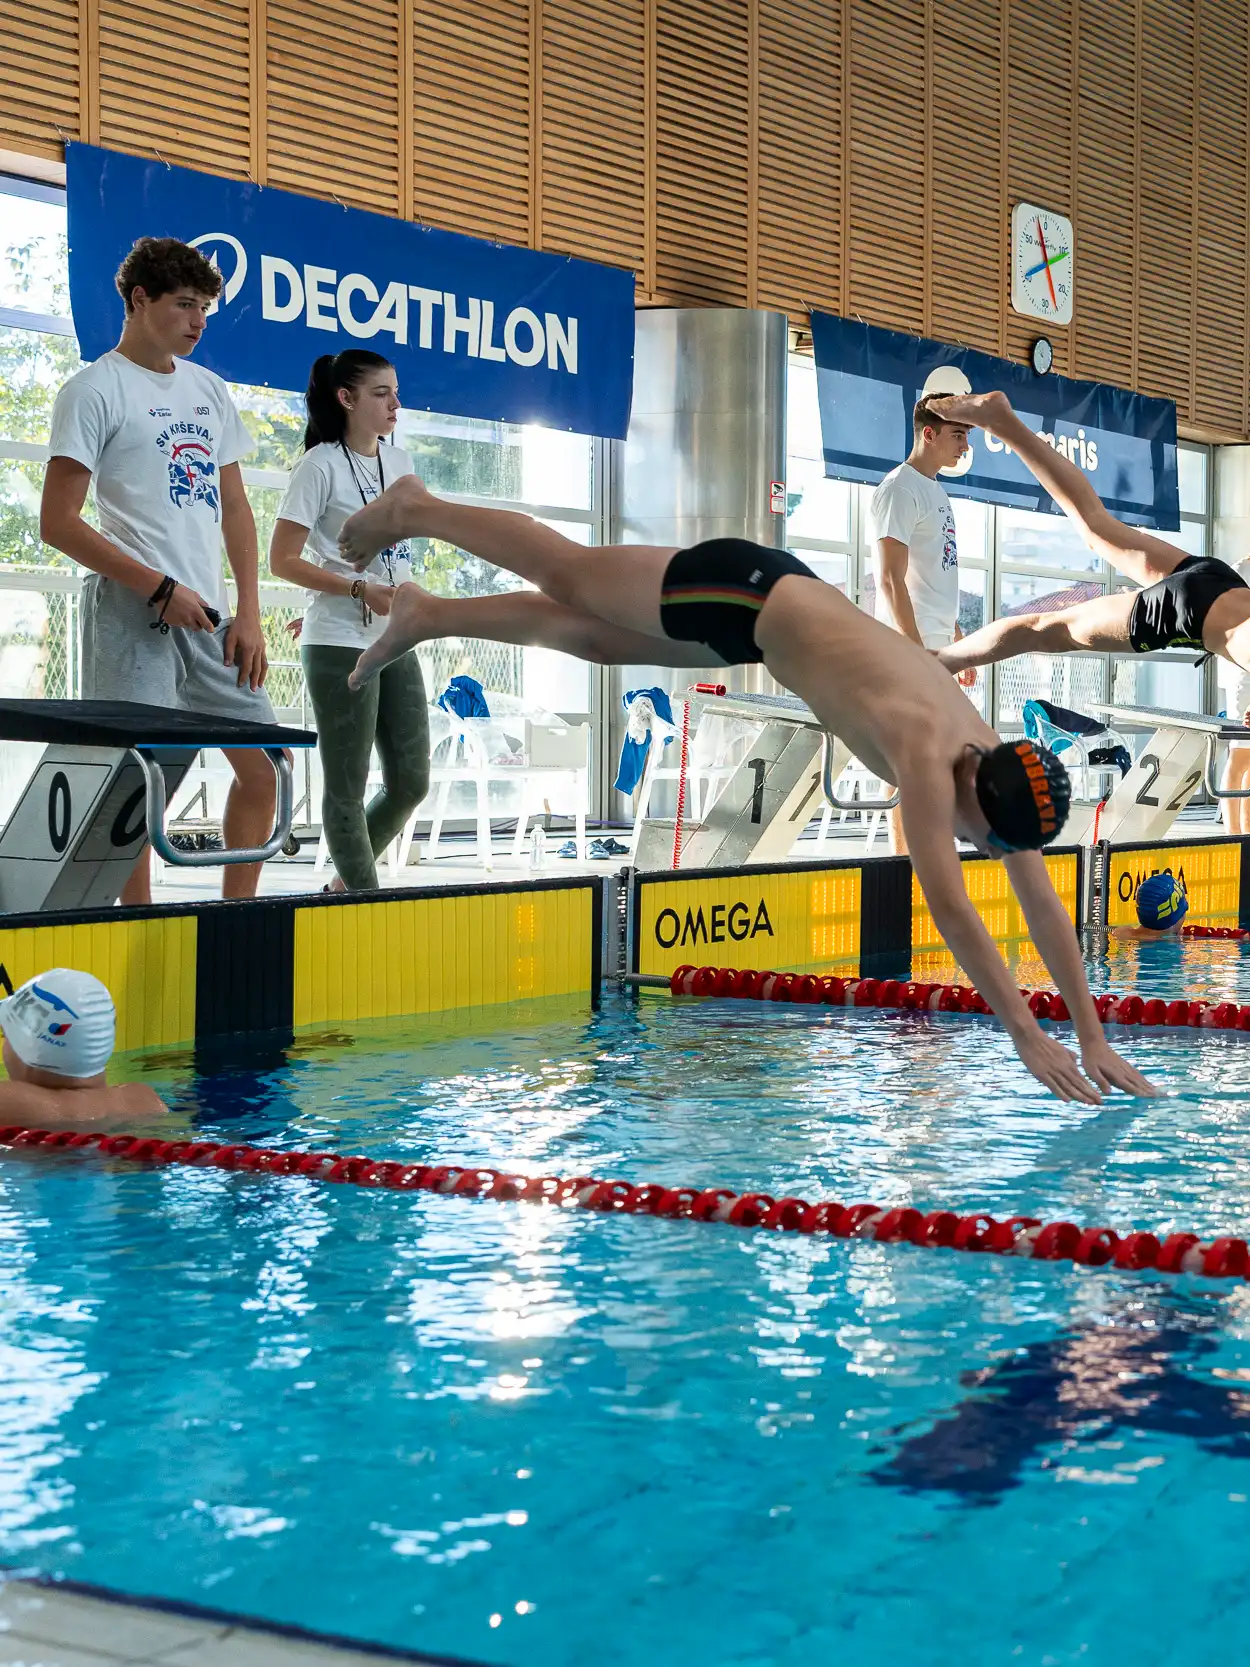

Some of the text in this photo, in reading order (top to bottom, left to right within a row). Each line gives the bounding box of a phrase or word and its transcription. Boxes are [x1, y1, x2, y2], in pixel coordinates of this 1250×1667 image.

[1025, 234, 1033, 245] 50
[1043, 221, 1048, 231] 0
[1041, 298, 1049, 309] 30
[1058, 283, 1066, 294] 20
[261, 254, 578, 375] DECATHLON
[156, 430, 170, 448] SV
[747, 757, 821, 824] 1 1
[1136, 754, 1202, 811] 2 2
[48, 771, 71, 853] 0
[655, 897, 774, 949] OMEGA
